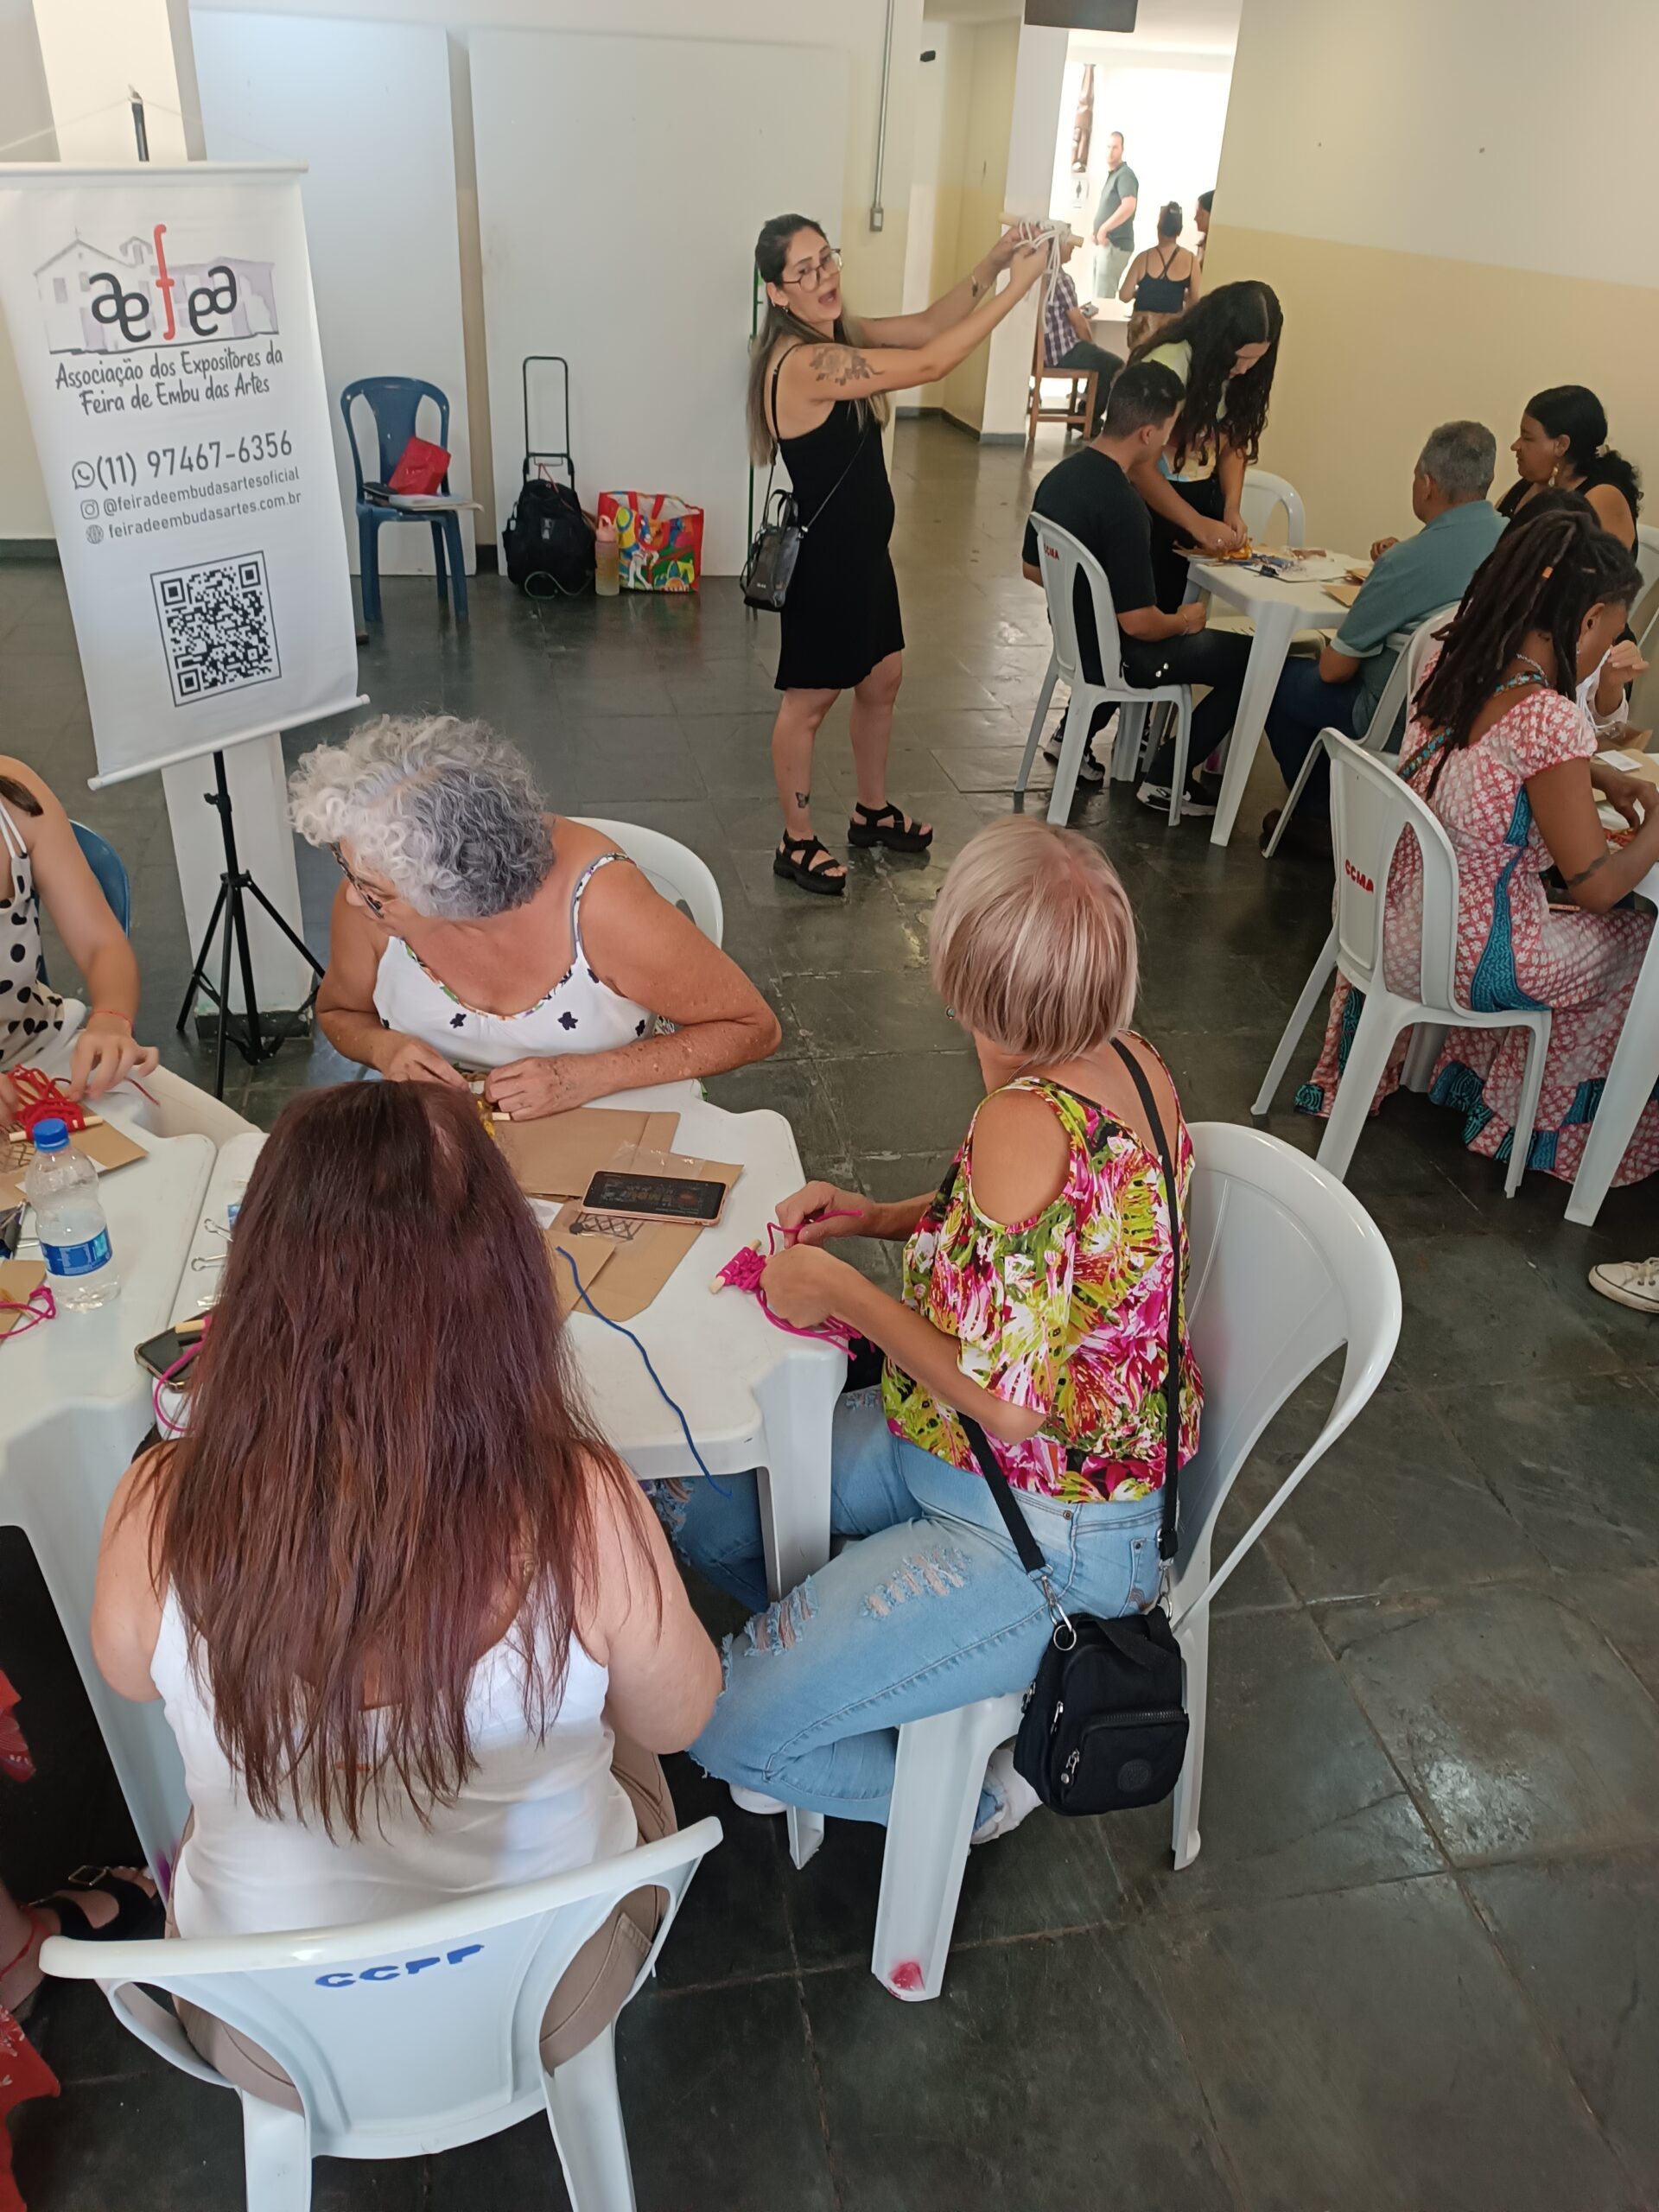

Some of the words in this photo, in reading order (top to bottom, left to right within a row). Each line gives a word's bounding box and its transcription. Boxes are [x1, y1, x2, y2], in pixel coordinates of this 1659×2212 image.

[55, 359, 143, 390] Associação
[150, 353, 175, 379] dos
[181, 346, 260, 379] Expositores
[266, 340, 283, 365] da
[79, 390, 124, 416] Feira
[131, 384, 153, 410] de
[156, 378, 200, 406] Embu
[206, 375, 230, 401] das
[234, 372, 270, 397] Artes
[97, 452, 137, 491] (11)
[147, 429, 292, 478] 97467-6356
[103, 467, 300, 516] @feiradeembudasartesoficial
[109, 492, 302, 538] feiradeembudasartes.com.br
